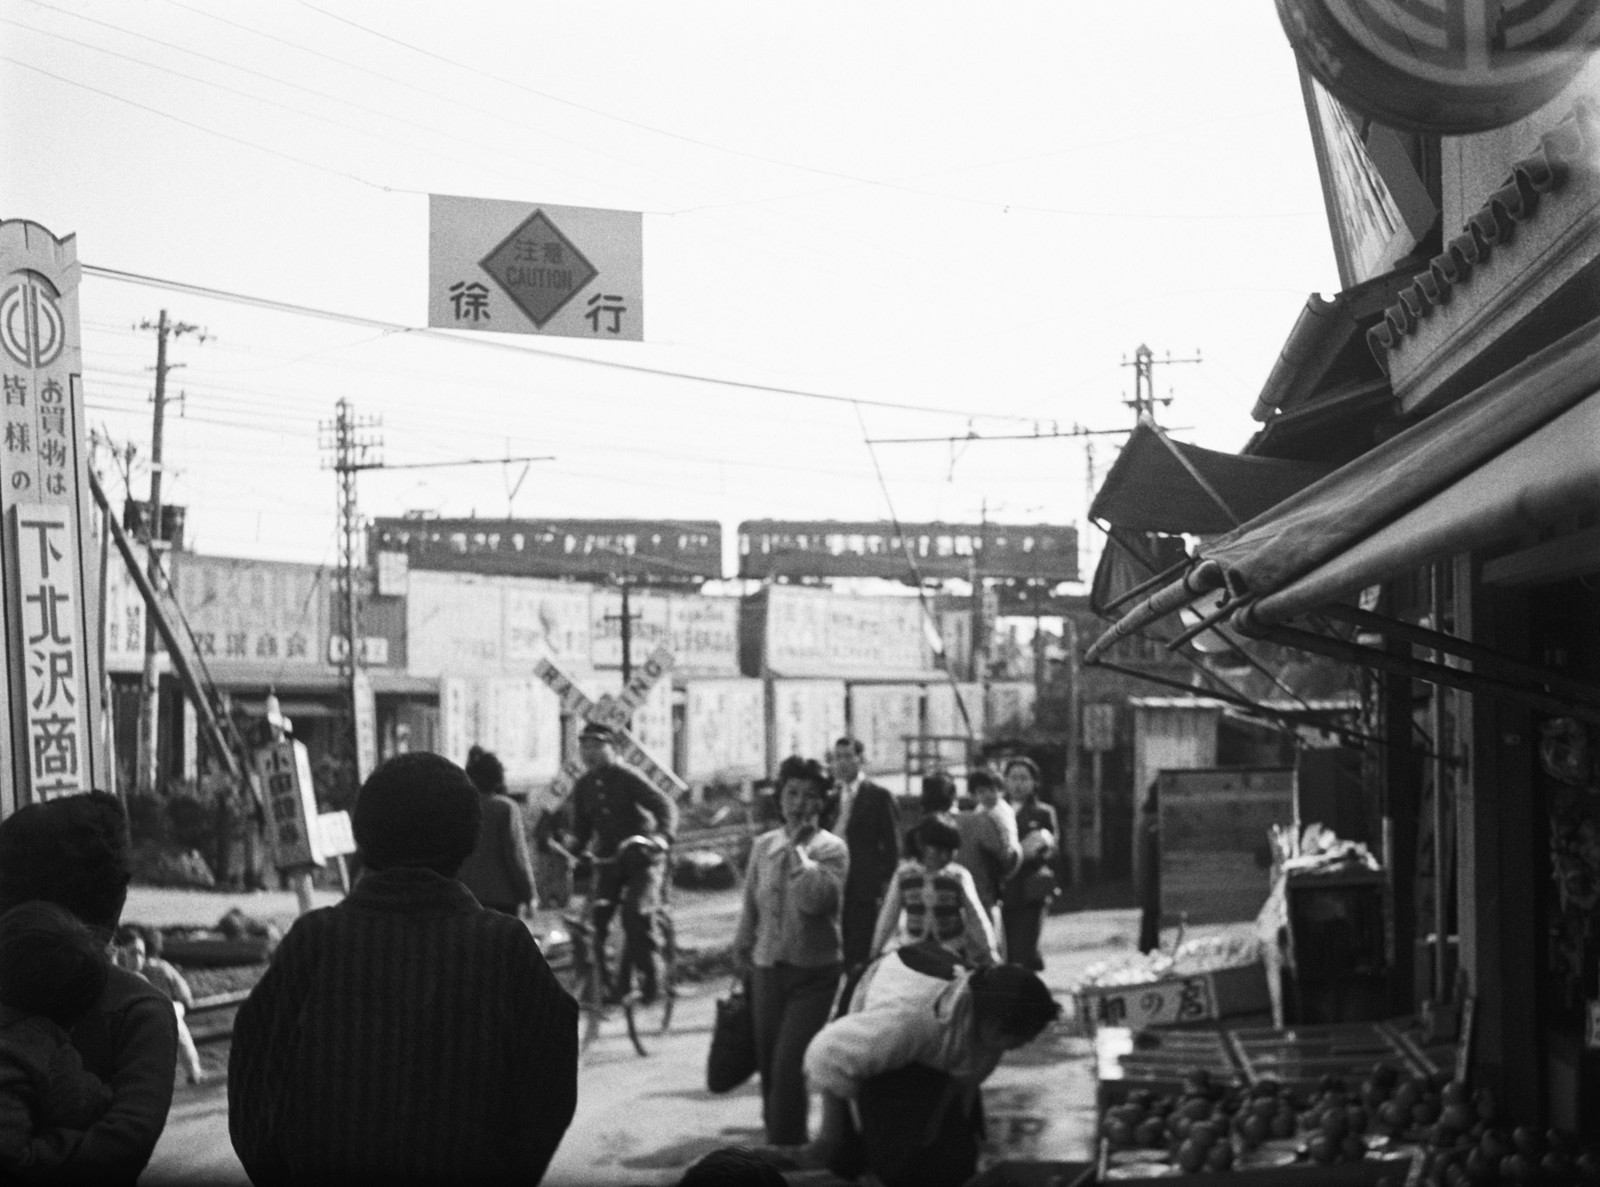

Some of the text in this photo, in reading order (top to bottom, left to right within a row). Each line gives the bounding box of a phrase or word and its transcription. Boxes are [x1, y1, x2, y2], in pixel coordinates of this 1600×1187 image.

[506, 265, 572, 290] CAUTION
[3, 373, 31, 491] 皆様の
[39, 377, 67, 496] お買物は
